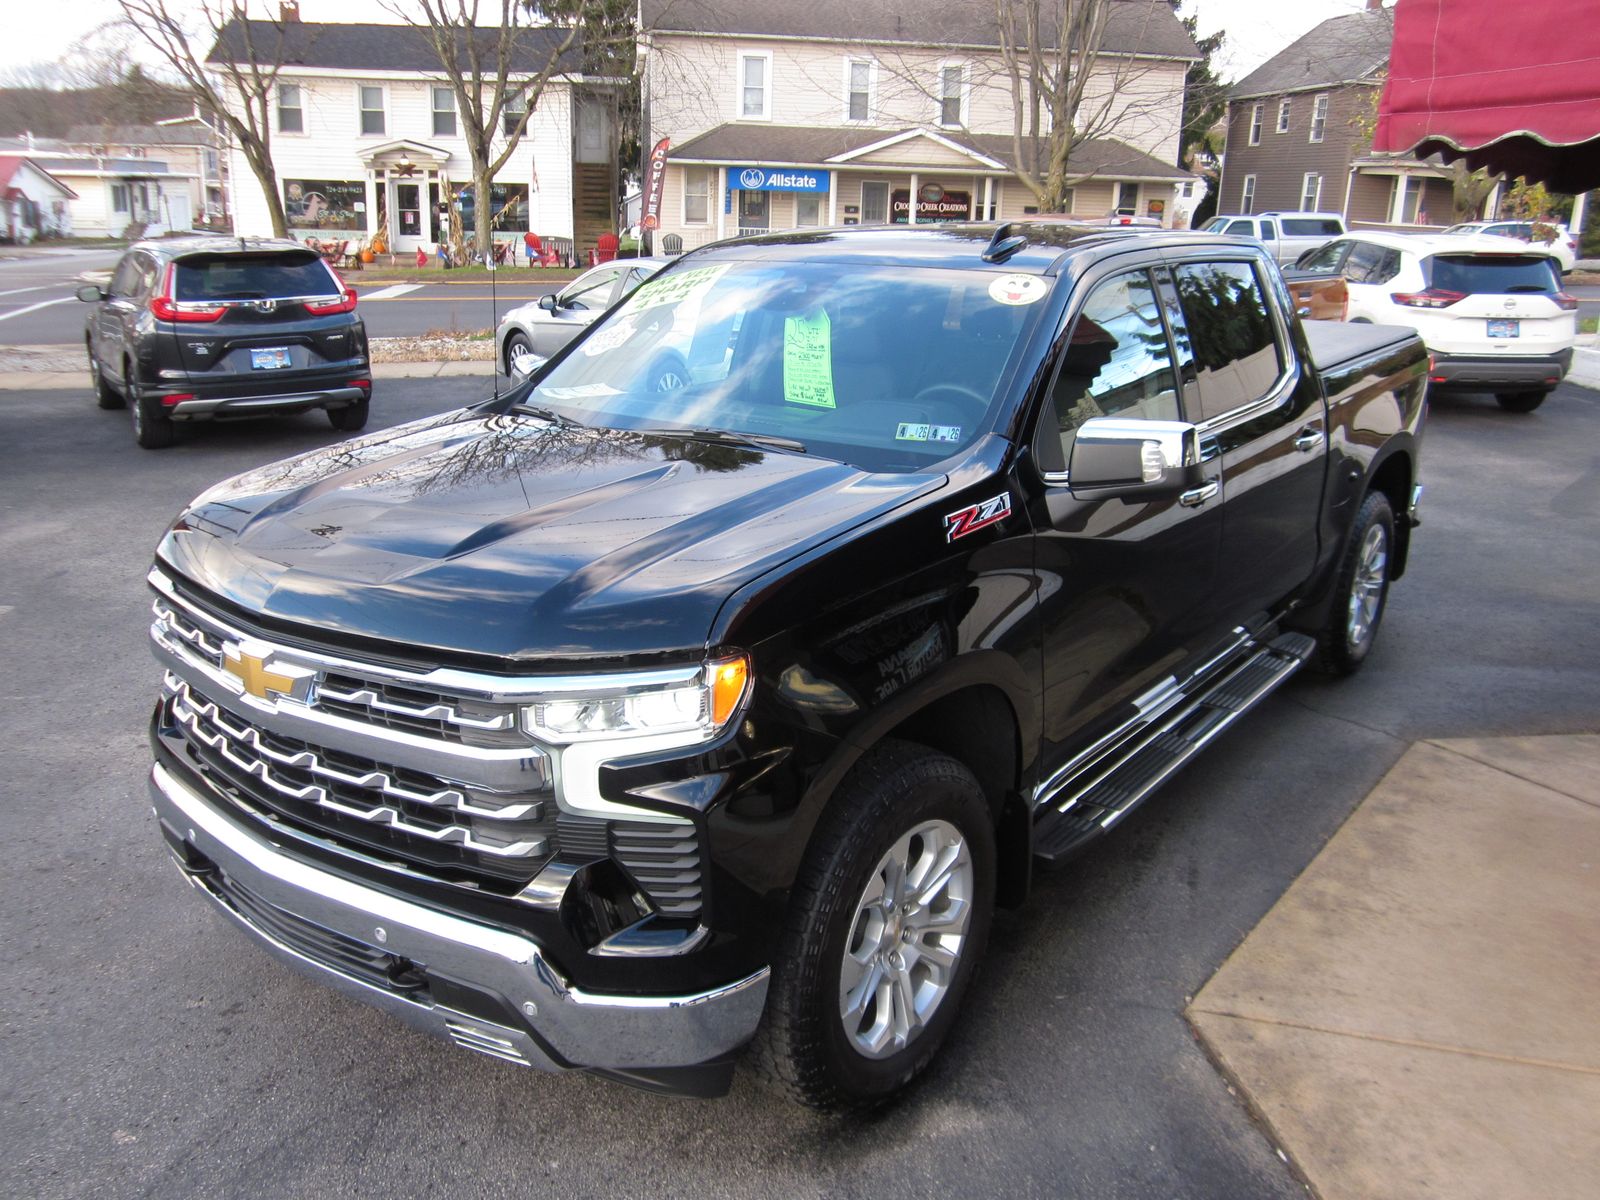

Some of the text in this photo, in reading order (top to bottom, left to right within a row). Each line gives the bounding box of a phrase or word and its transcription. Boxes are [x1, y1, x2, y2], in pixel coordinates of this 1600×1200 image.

[648, 149, 664, 213] COFFEE
[766, 173, 817, 188] Allstate
[634, 276, 712, 302] SHARP
[943, 491, 1011, 543] Z71
